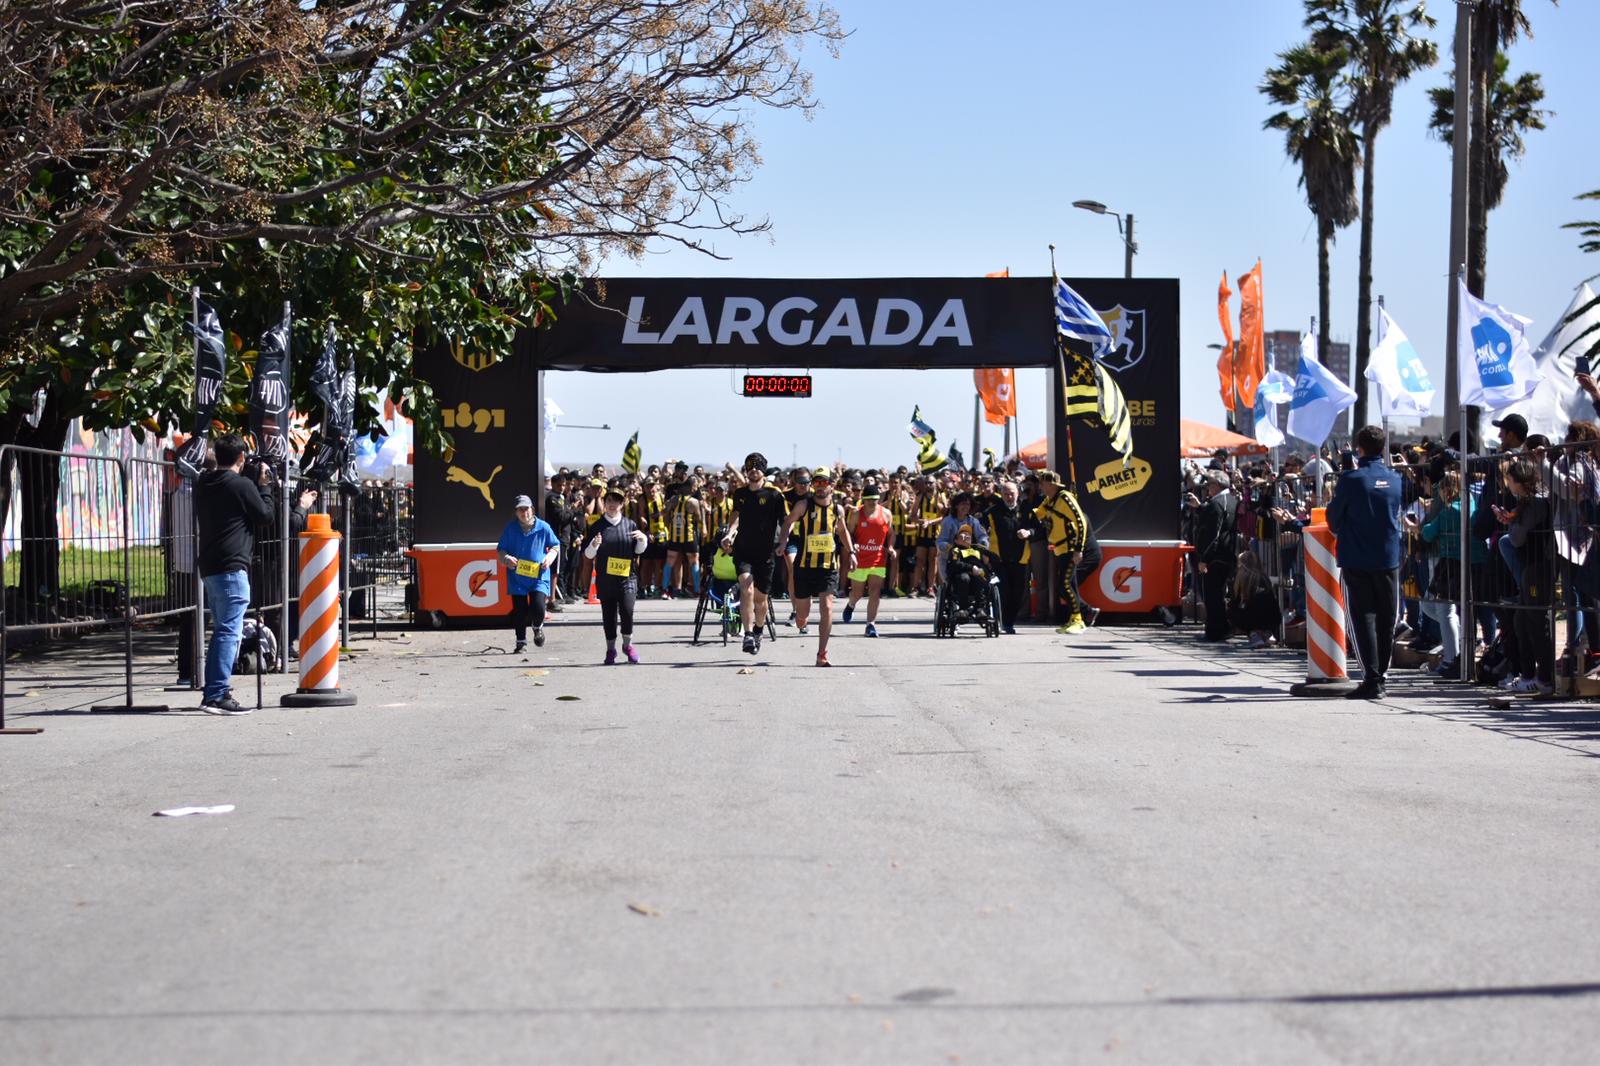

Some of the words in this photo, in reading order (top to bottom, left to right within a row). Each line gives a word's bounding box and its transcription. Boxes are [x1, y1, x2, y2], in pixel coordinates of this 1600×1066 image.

[621, 296, 974, 346] LARGADA
[745, 377, 809, 392] 00:00:00
[441, 402, 505, 432] 1891
